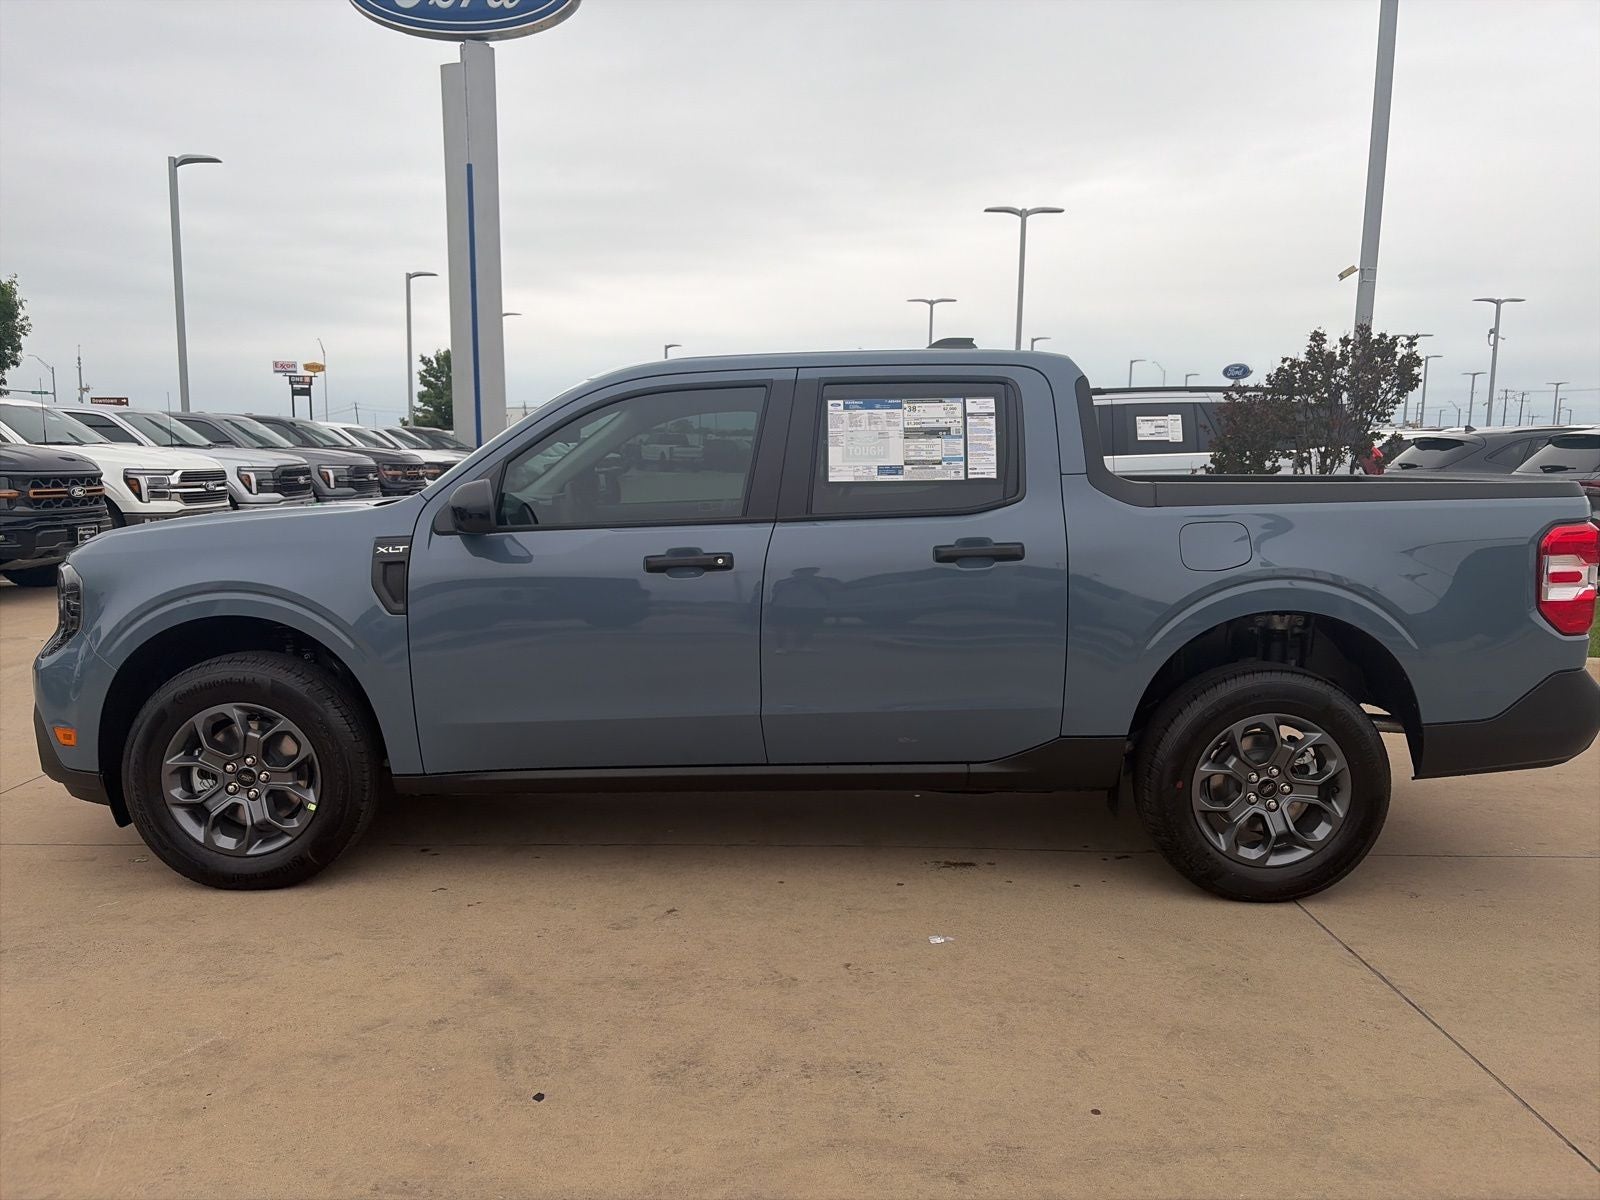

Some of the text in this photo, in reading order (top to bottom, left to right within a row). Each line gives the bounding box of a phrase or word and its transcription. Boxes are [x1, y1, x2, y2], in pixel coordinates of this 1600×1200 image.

[275, 361, 296, 369] Exxon
[907, 405, 917, 413] 38
[848, 446, 884, 456] TOUGH
[376, 545, 409, 554] XLT
